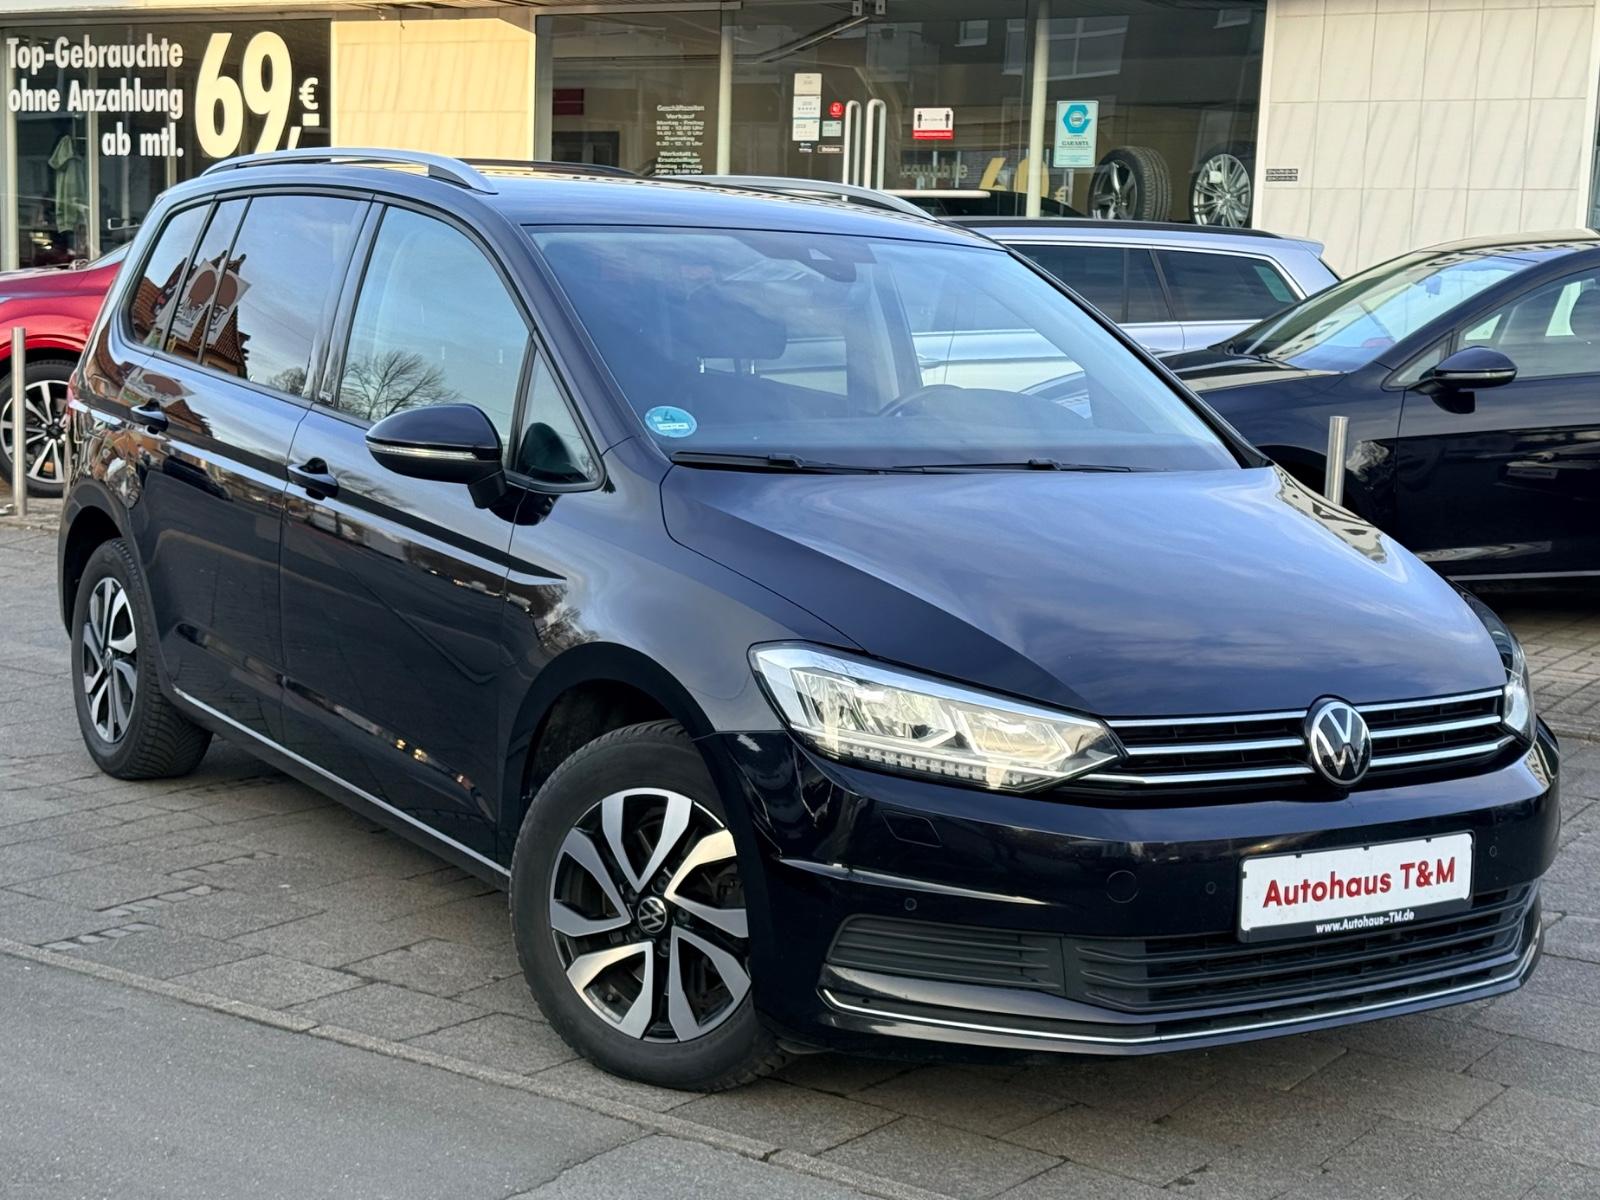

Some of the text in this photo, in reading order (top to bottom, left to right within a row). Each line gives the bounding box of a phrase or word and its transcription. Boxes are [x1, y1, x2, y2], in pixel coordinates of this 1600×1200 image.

[7, 34, 183, 74] Top-Gebrauchte
[8, 77, 183, 119] ohne Anzahlung
[102, 122, 184, 157] ab mtl.
[1262, 856, 1456, 908] Autohaus T&M
[1316, 910, 1415, 934] www.Autohaus-TM.de
